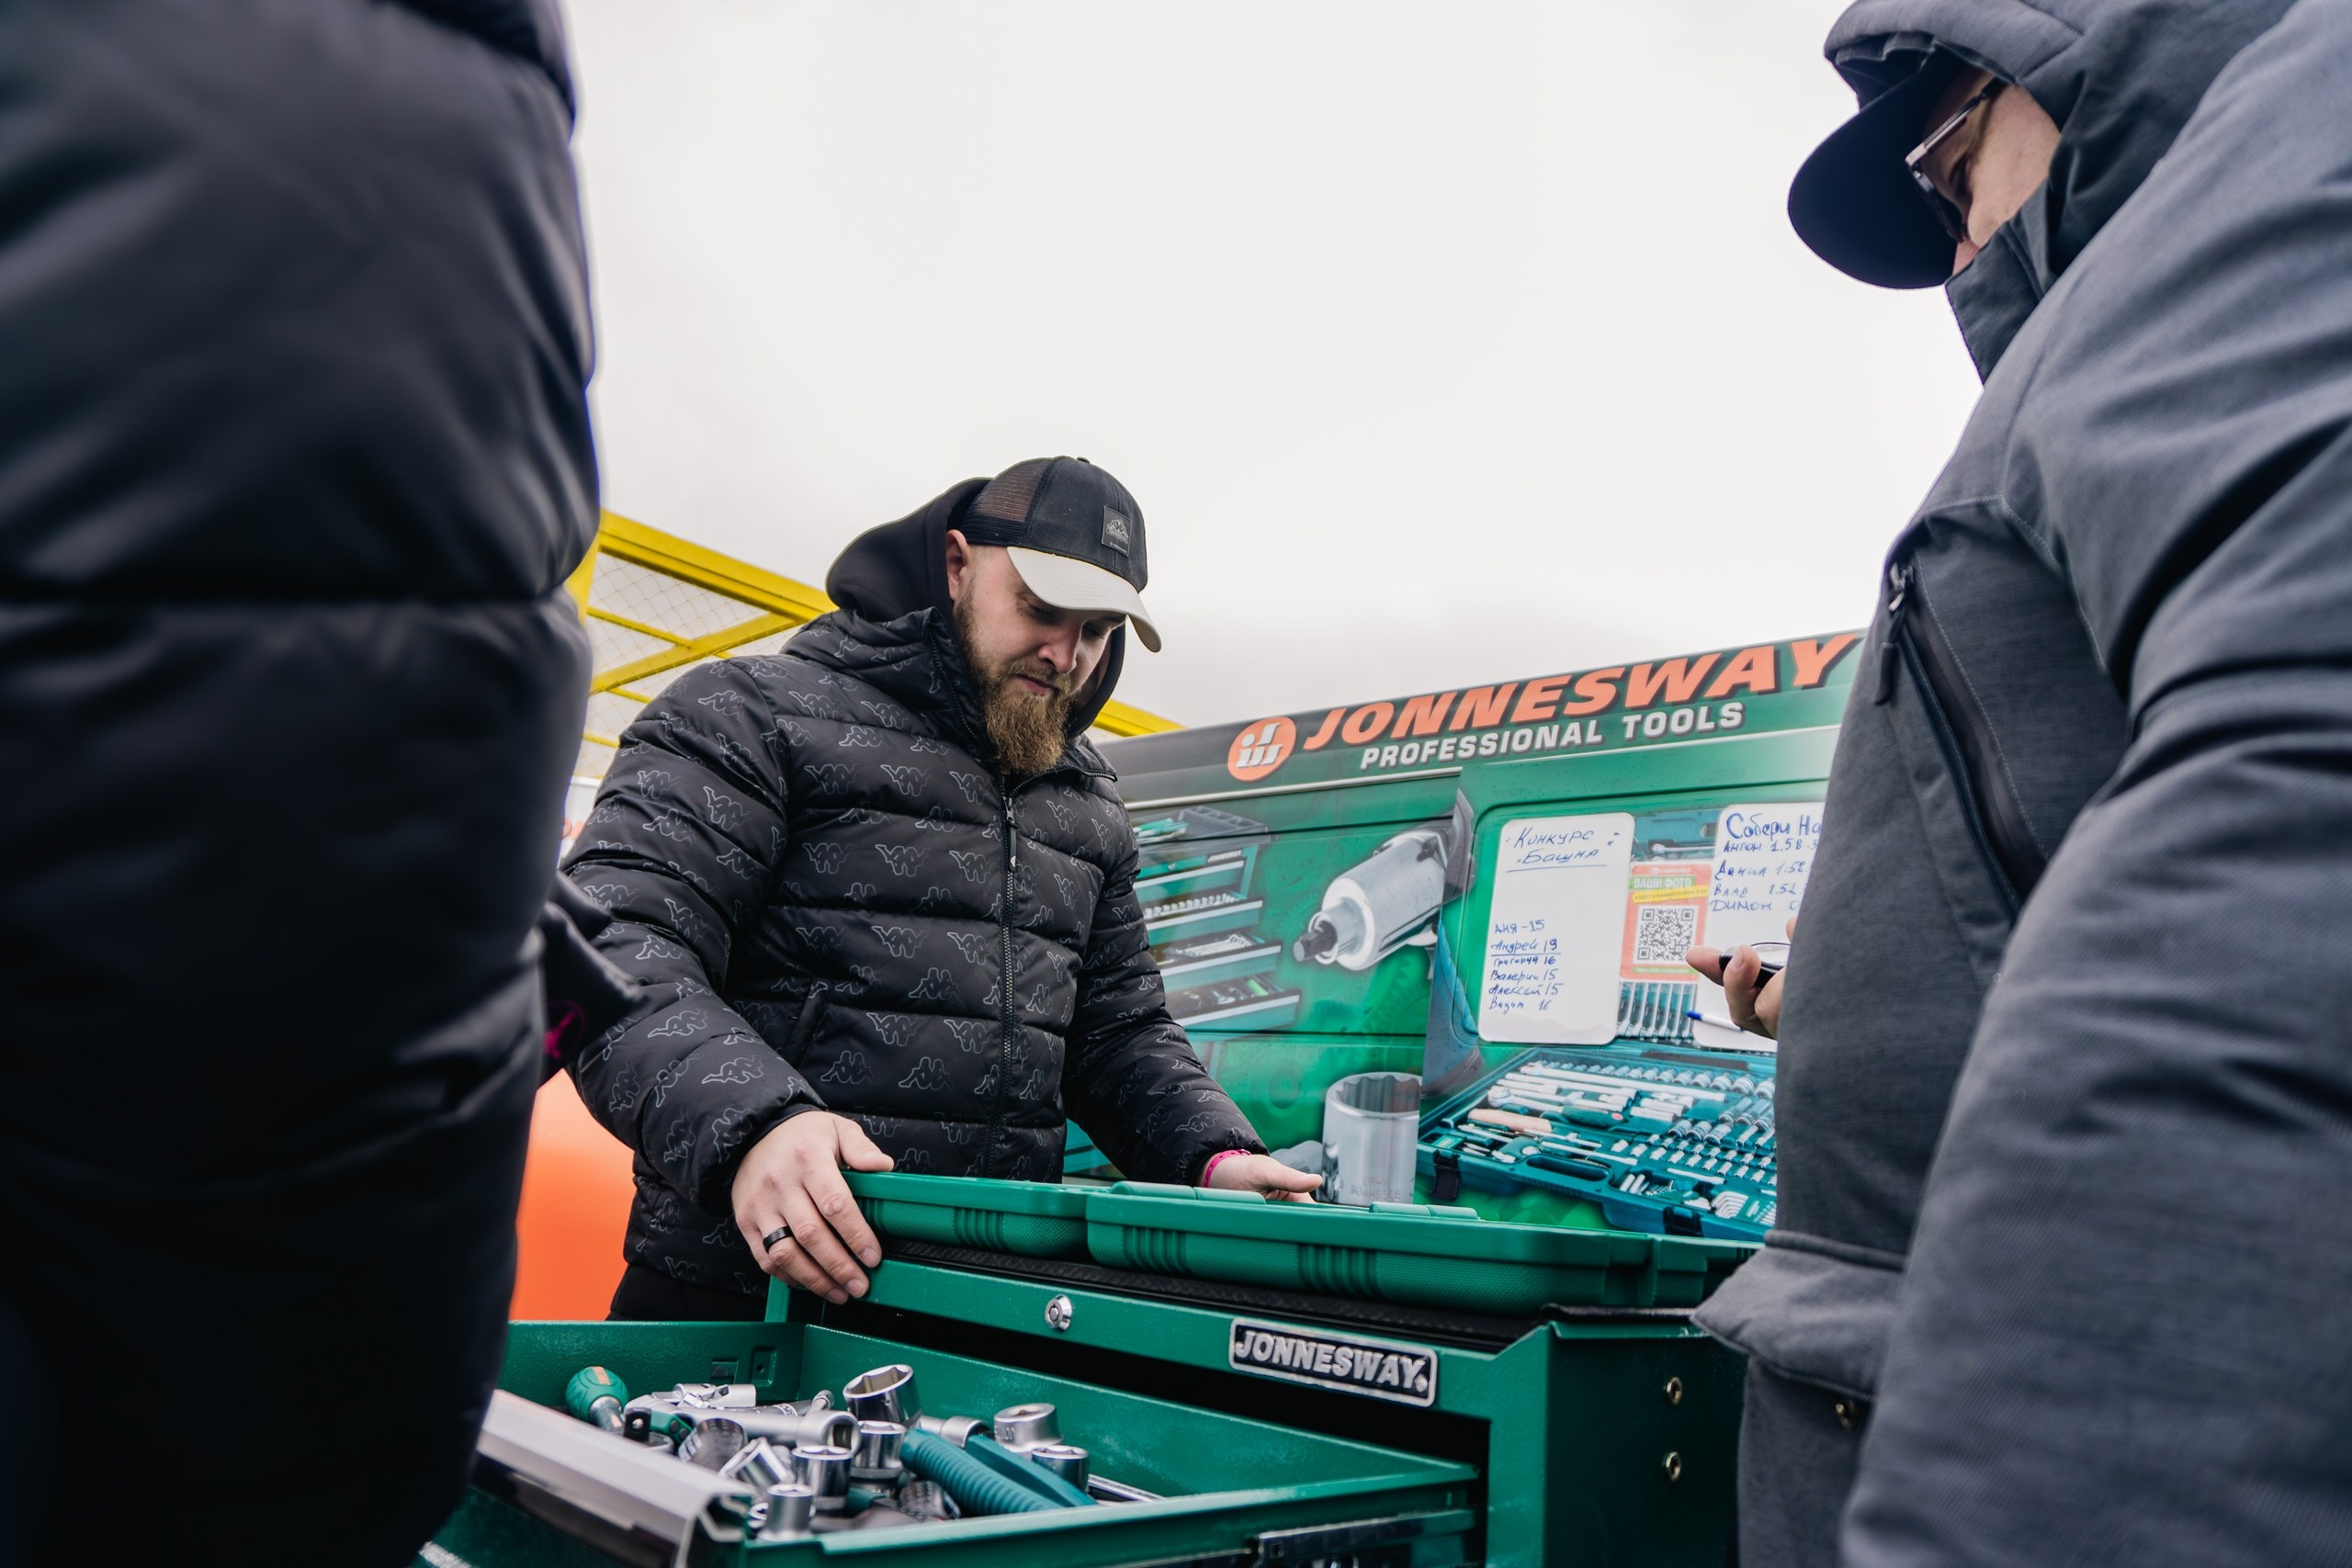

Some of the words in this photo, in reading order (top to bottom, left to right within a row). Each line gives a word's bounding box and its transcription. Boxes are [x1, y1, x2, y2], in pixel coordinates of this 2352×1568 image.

[1303, 633, 1858, 750] JONNESWAY
[1360, 720, 1602, 771] PROFESSIONAL
[1622, 701, 1745, 739] TOOLS
[1634, 877, 1662, 888] ВАШИ
[1665, 876, 1692, 888] ФОТО
[1544, 938, 1557, 953] 19
[1544, 955, 1556, 965] 16
[1544, 968, 1559, 981] 15
[1545, 982, 1565, 996] 15
[1235, 1329, 1428, 1393] JONNESWAY
